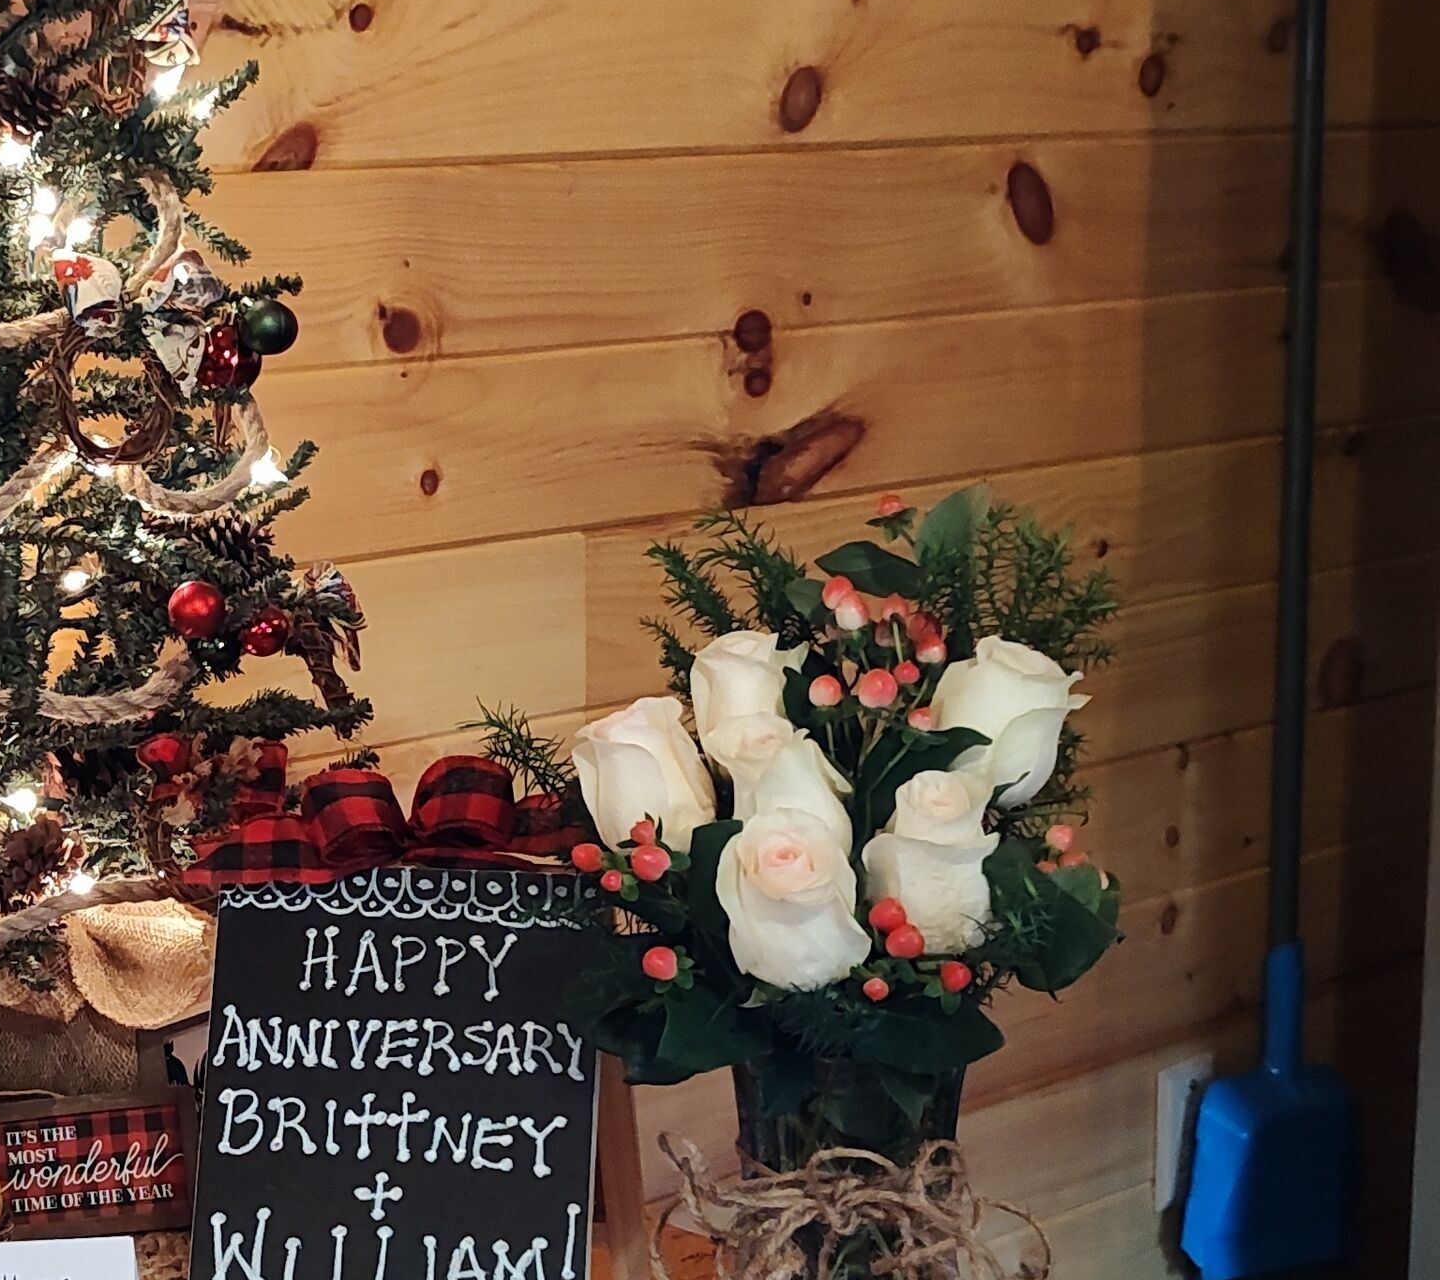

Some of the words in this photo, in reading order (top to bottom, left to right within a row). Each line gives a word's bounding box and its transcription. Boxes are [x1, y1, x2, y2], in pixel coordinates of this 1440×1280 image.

[299, 925, 518, 1002] HAPPY
[212, 1003, 585, 1081] ANNIVERSARY
[6, 1129, 38, 1147] IT'S
[40, 1125, 77, 1142] THE
[7, 1147, 57, 1166] MOST
[1, 1133, 184, 1195] wonderful
[11, 1194, 58, 1214] TIME
[61, 1191, 85, 1209] OF
[86, 1188, 124, 1206] THE
[126, 1182, 174, 1202] YEAR
